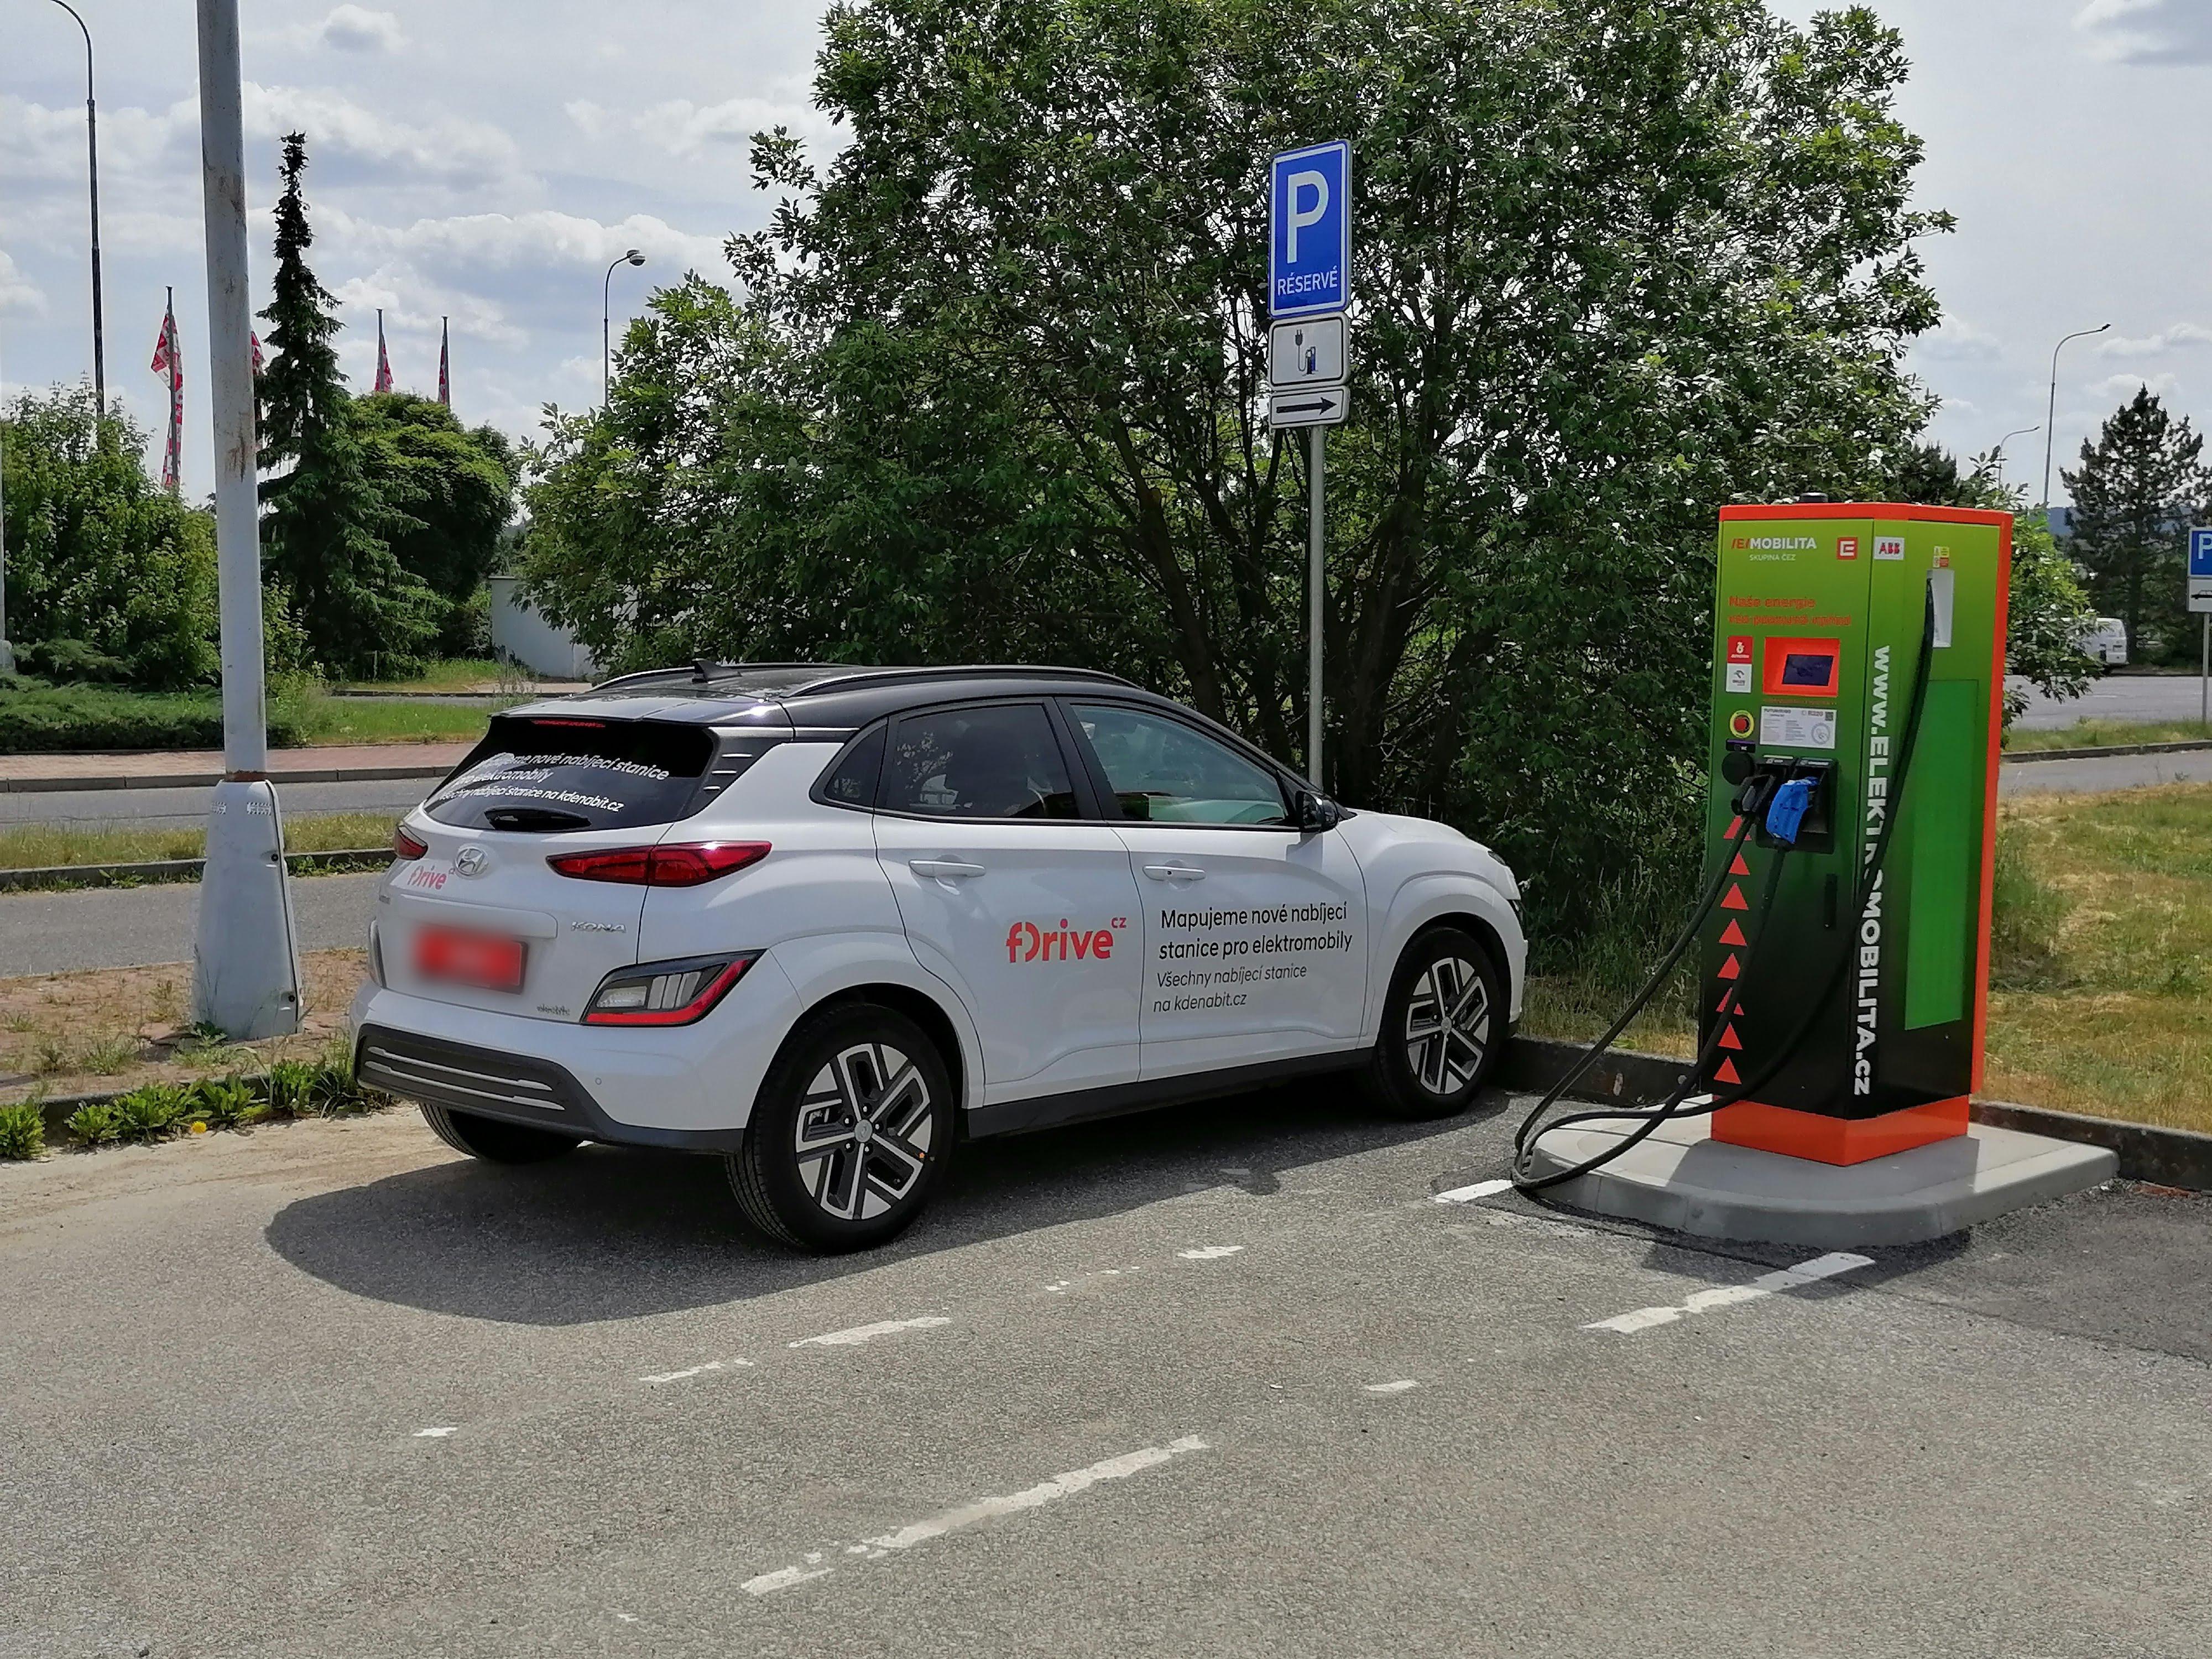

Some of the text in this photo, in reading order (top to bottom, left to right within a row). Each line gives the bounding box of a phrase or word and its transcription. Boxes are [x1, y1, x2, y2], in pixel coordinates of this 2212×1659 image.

[1287, 170, 1329, 264] P
[1277, 265, 1338, 297] RÉSERVÉ
[1879, 542, 1900, 555] ABB
[2198, 533, 2212, 560] P
[613, 761, 670, 780] stanice
[541, 790, 560, 800] na
[557, 790, 624, 812] kdenabit.cz
[571, 921, 627, 933] KONA
[1161, 901, 1347, 932] Mapujeme nové nabíjecí
[1159, 930, 1353, 960] stanice pro elektromobily
[1157, 963, 1307, 988] Všechny nabíjecí stanice
[1153, 991, 1248, 1013] na kdenabit.cz
